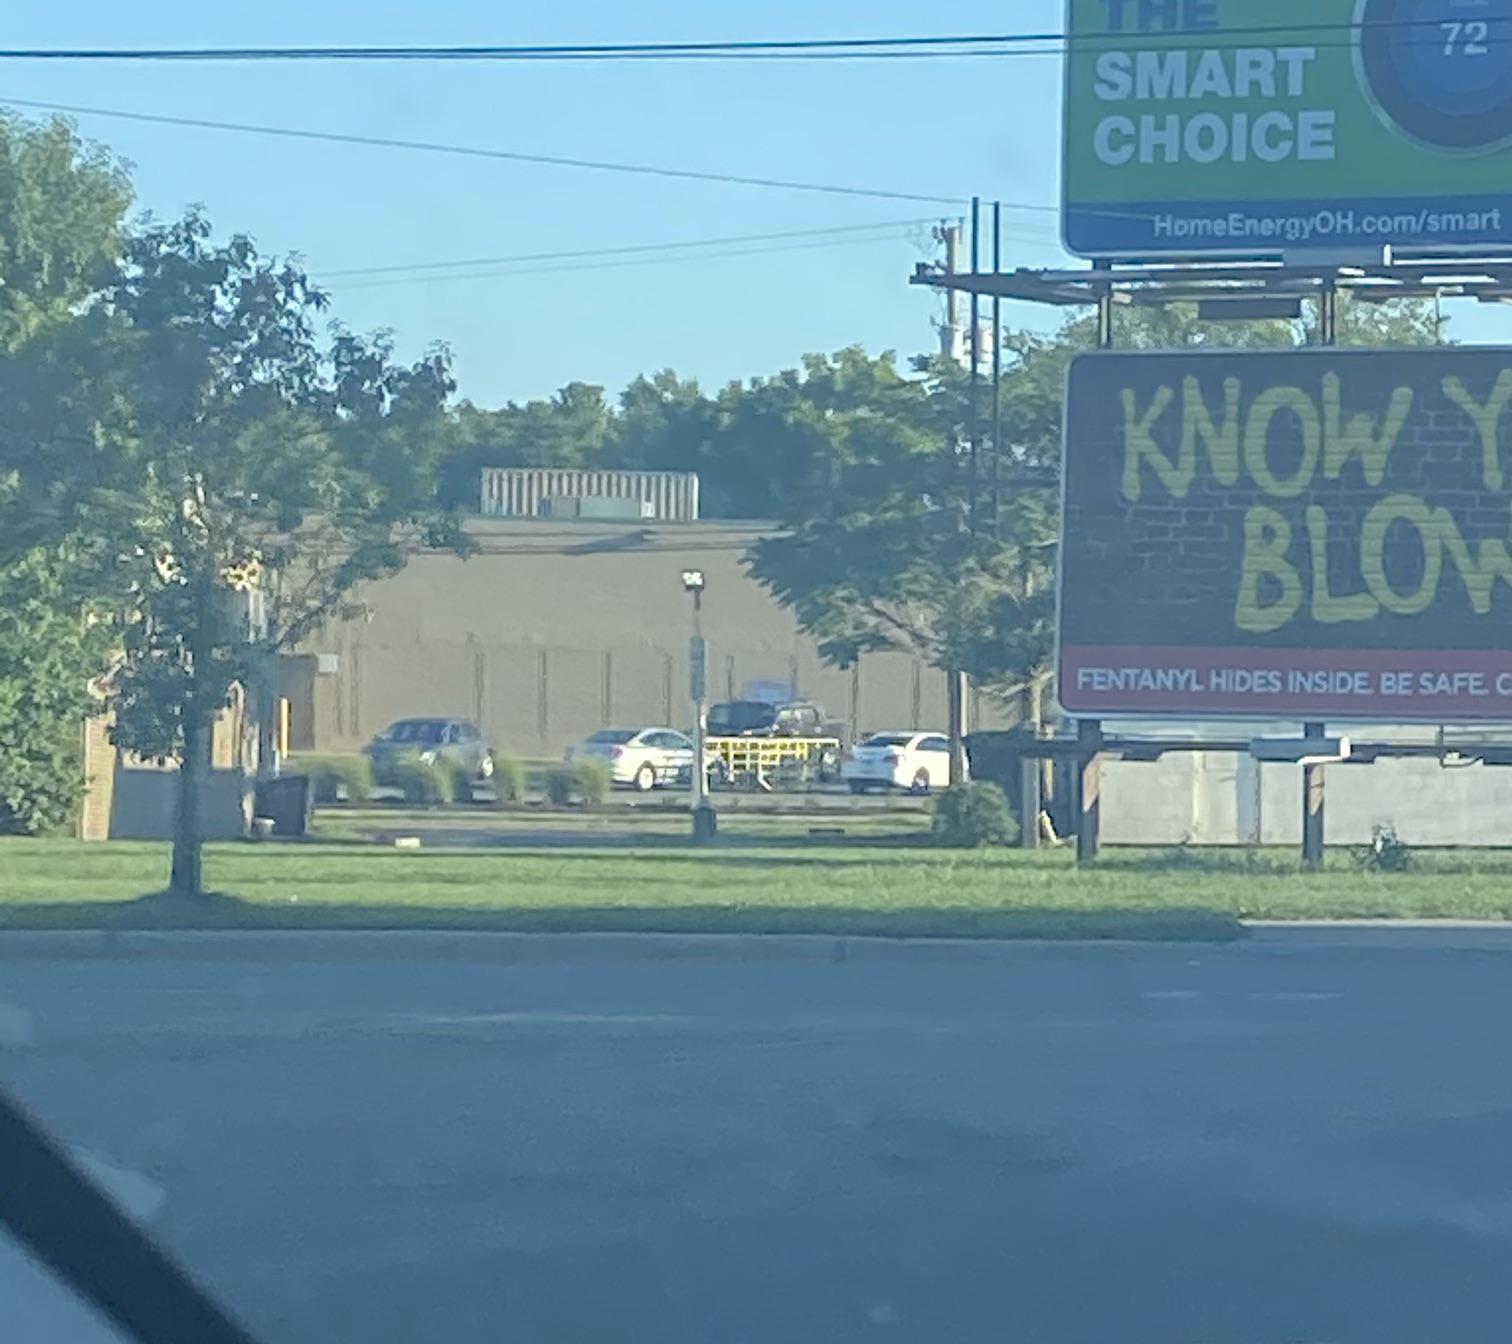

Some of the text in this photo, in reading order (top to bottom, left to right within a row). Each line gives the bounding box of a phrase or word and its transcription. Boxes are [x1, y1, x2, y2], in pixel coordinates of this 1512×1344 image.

[1440, 22, 1488, 55] 72
[1094, 47, 1316, 100] SMART
[1093, 111, 1335, 165] CHOICE
[1153, 208, 1501, 240] HomeEnergyOH.com/smart
[1121, 370, 1413, 501] KNOW
[1077, 667, 1204, 691] FENTANYL
[1210, 669, 1281, 692] HIDES
[1380, 672, 1413, 695] BE
